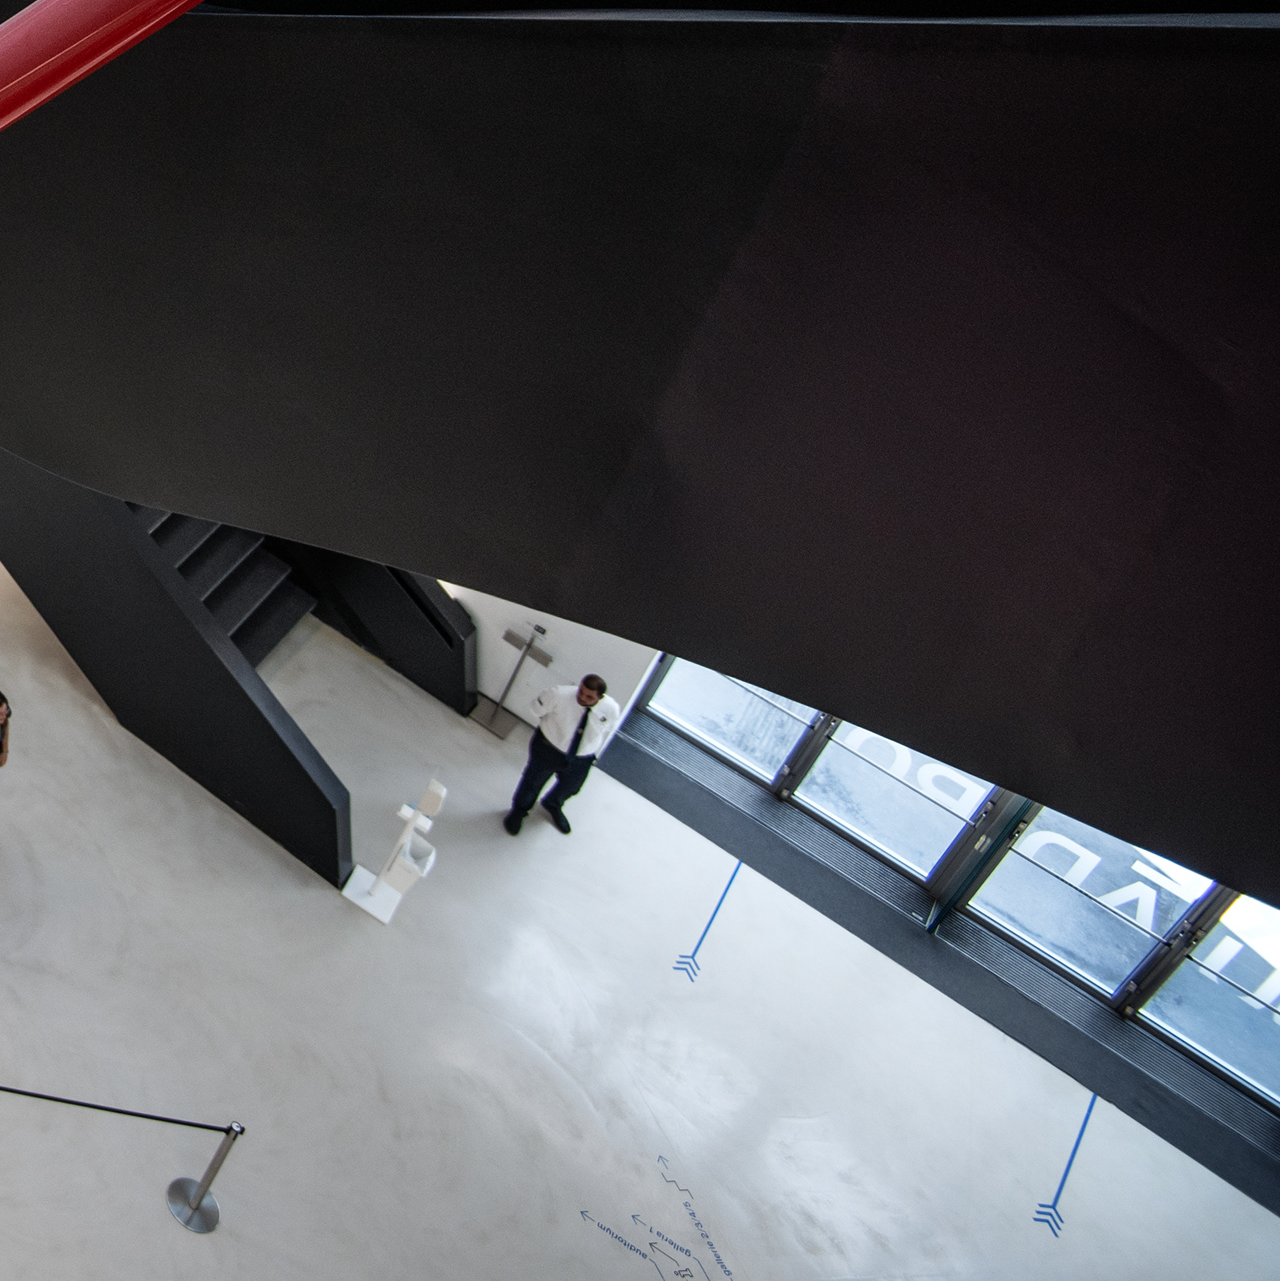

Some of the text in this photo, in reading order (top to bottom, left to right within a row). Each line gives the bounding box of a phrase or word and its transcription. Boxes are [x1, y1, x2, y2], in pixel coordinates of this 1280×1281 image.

[682, 1201, 710, 1239] 2/3/4/5
[597, 1221, 648, 1260] auditorium
[656, 1229, 692, 1257] galleria
